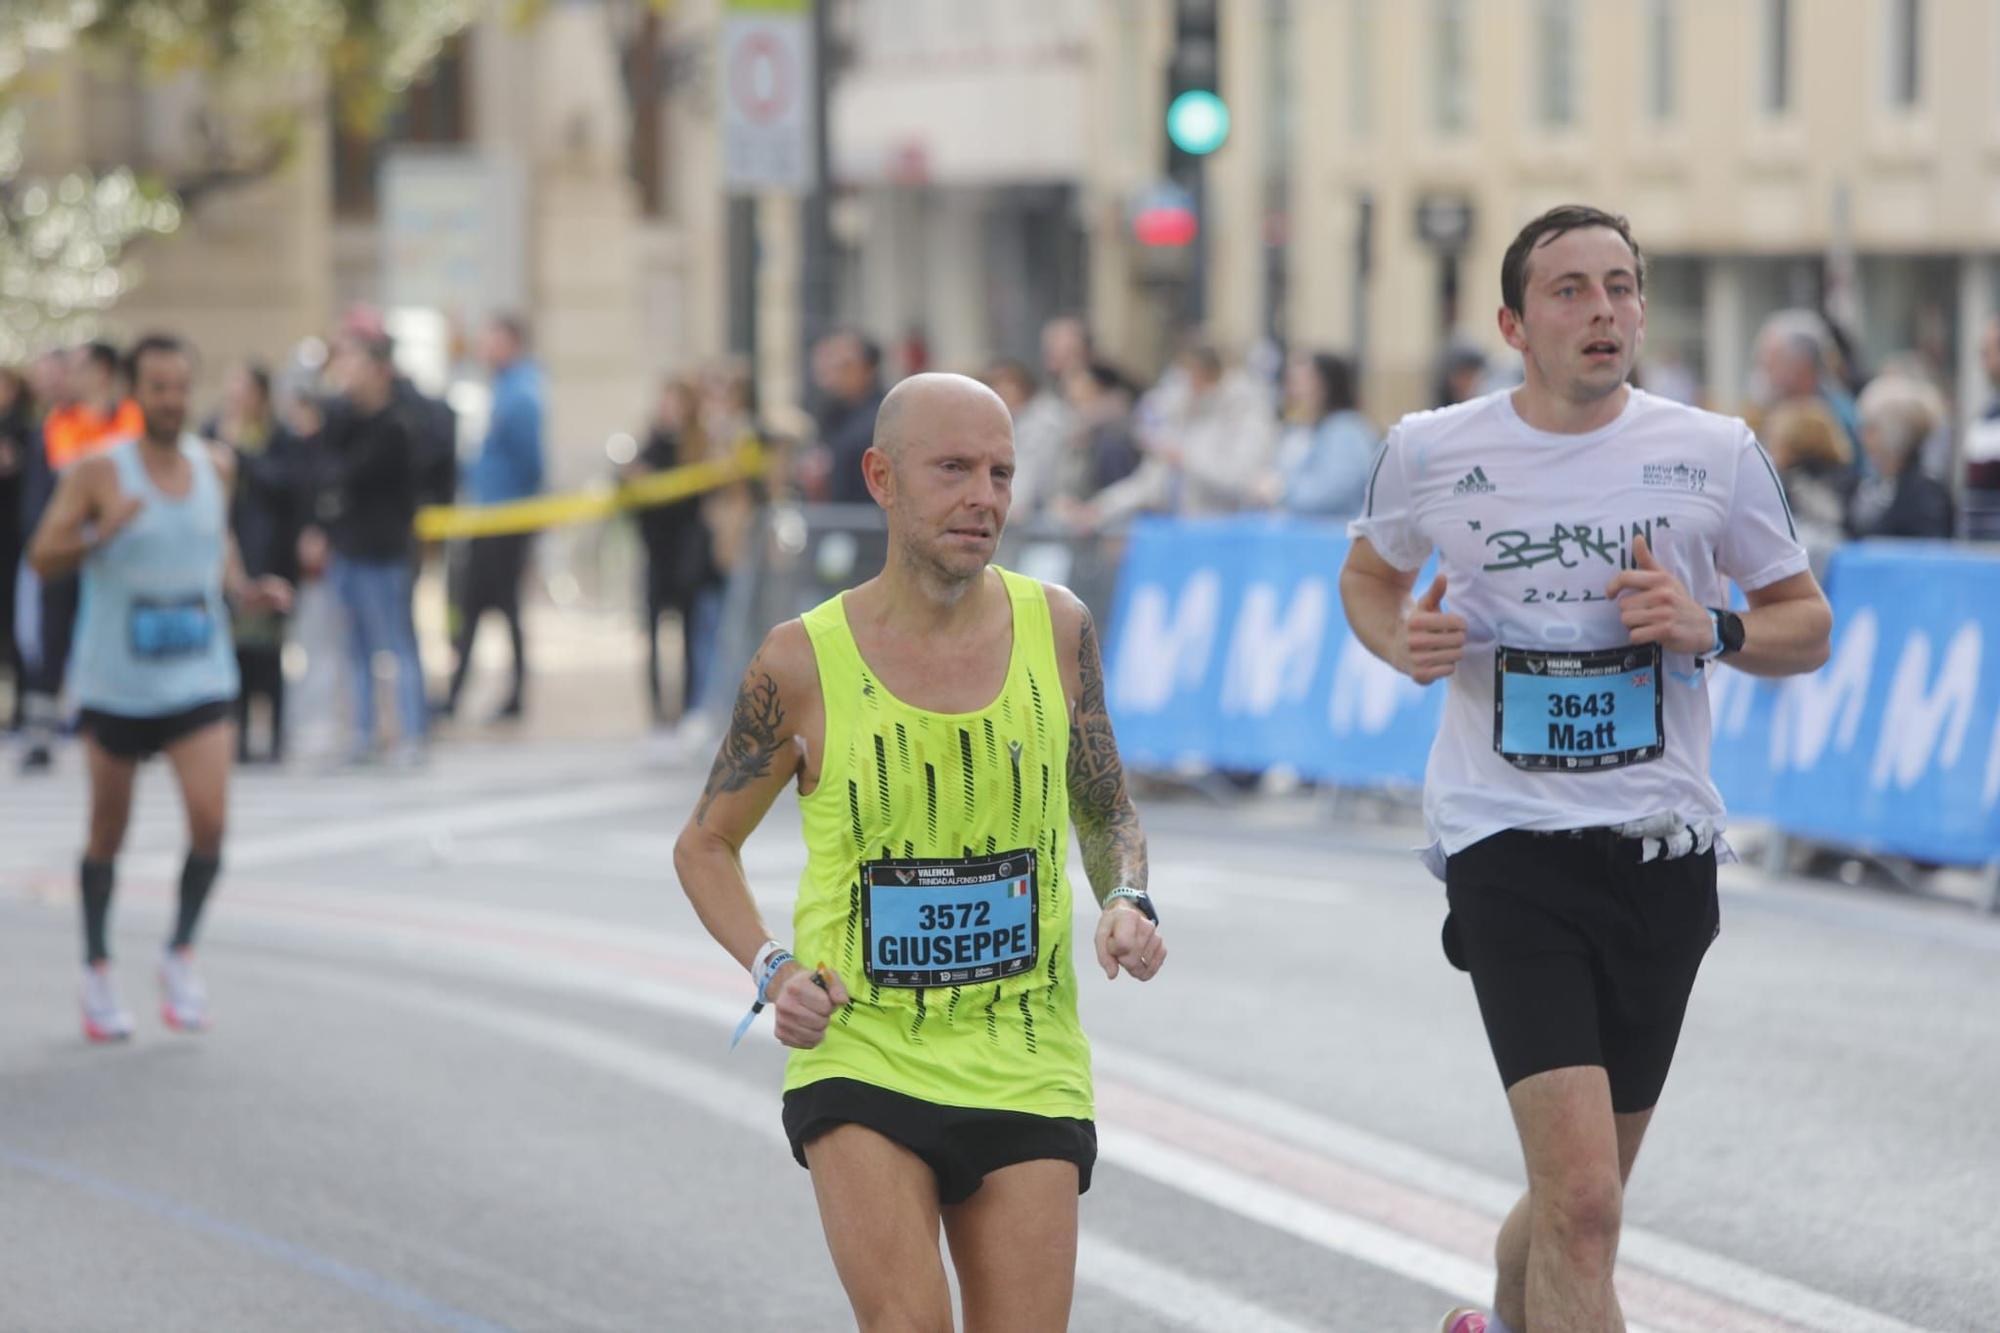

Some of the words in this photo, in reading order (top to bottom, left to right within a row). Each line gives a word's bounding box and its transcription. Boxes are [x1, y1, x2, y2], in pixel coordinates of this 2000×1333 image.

[1547, 692, 1616, 718] 3643
[1548, 721, 1617, 750] Matt
[918, 868, 954, 877] VALENCIA
[918, 877, 948, 886] TRINIDAD
[948, 876, 978, 885] ALFONSO
[978, 874, 996, 882] 2022
[919, 901, 990, 931] 3572
[878, 924, 1026, 966] GIUSEPPE
